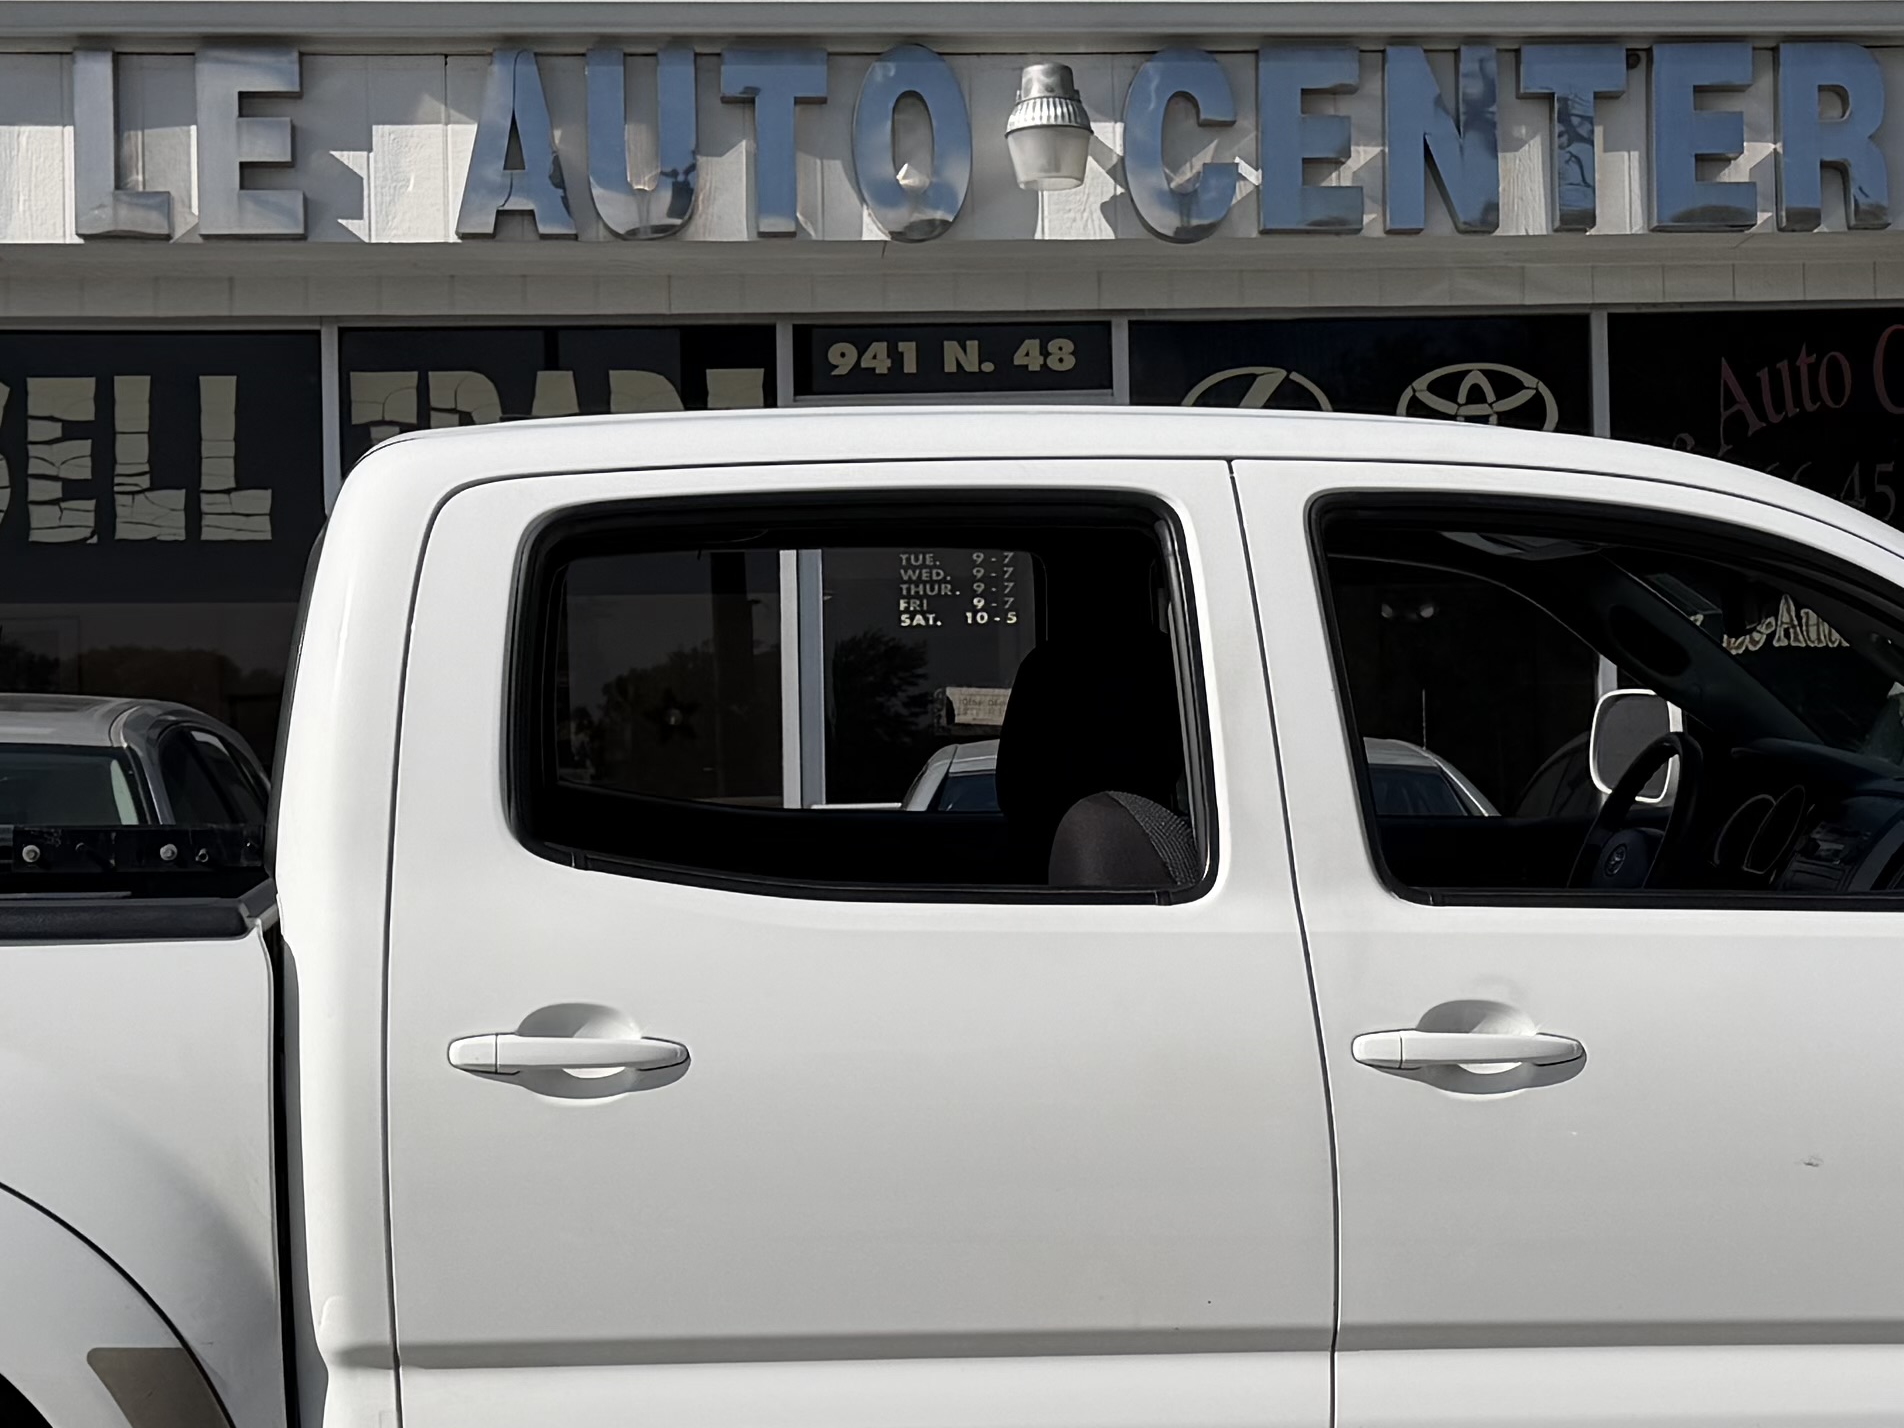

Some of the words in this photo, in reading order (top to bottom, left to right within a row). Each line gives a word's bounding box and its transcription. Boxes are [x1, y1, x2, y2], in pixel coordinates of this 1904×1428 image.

[73, 46, 307, 241] LE
[456, 42, 973, 244] AUTO
[1122, 40, 1893, 244] CENTER
[827, 340, 920, 376] 941
[943, 339, 995, 374] N.
[1013, 337, 1077, 372] 48
[1718, 342, 1853, 457] Auto
[899, 553, 941, 566] TUE.
[899, 568, 952, 581] WED.
[899, 583, 961, 596] THUR.
[899, 613, 943, 627] SAT.
